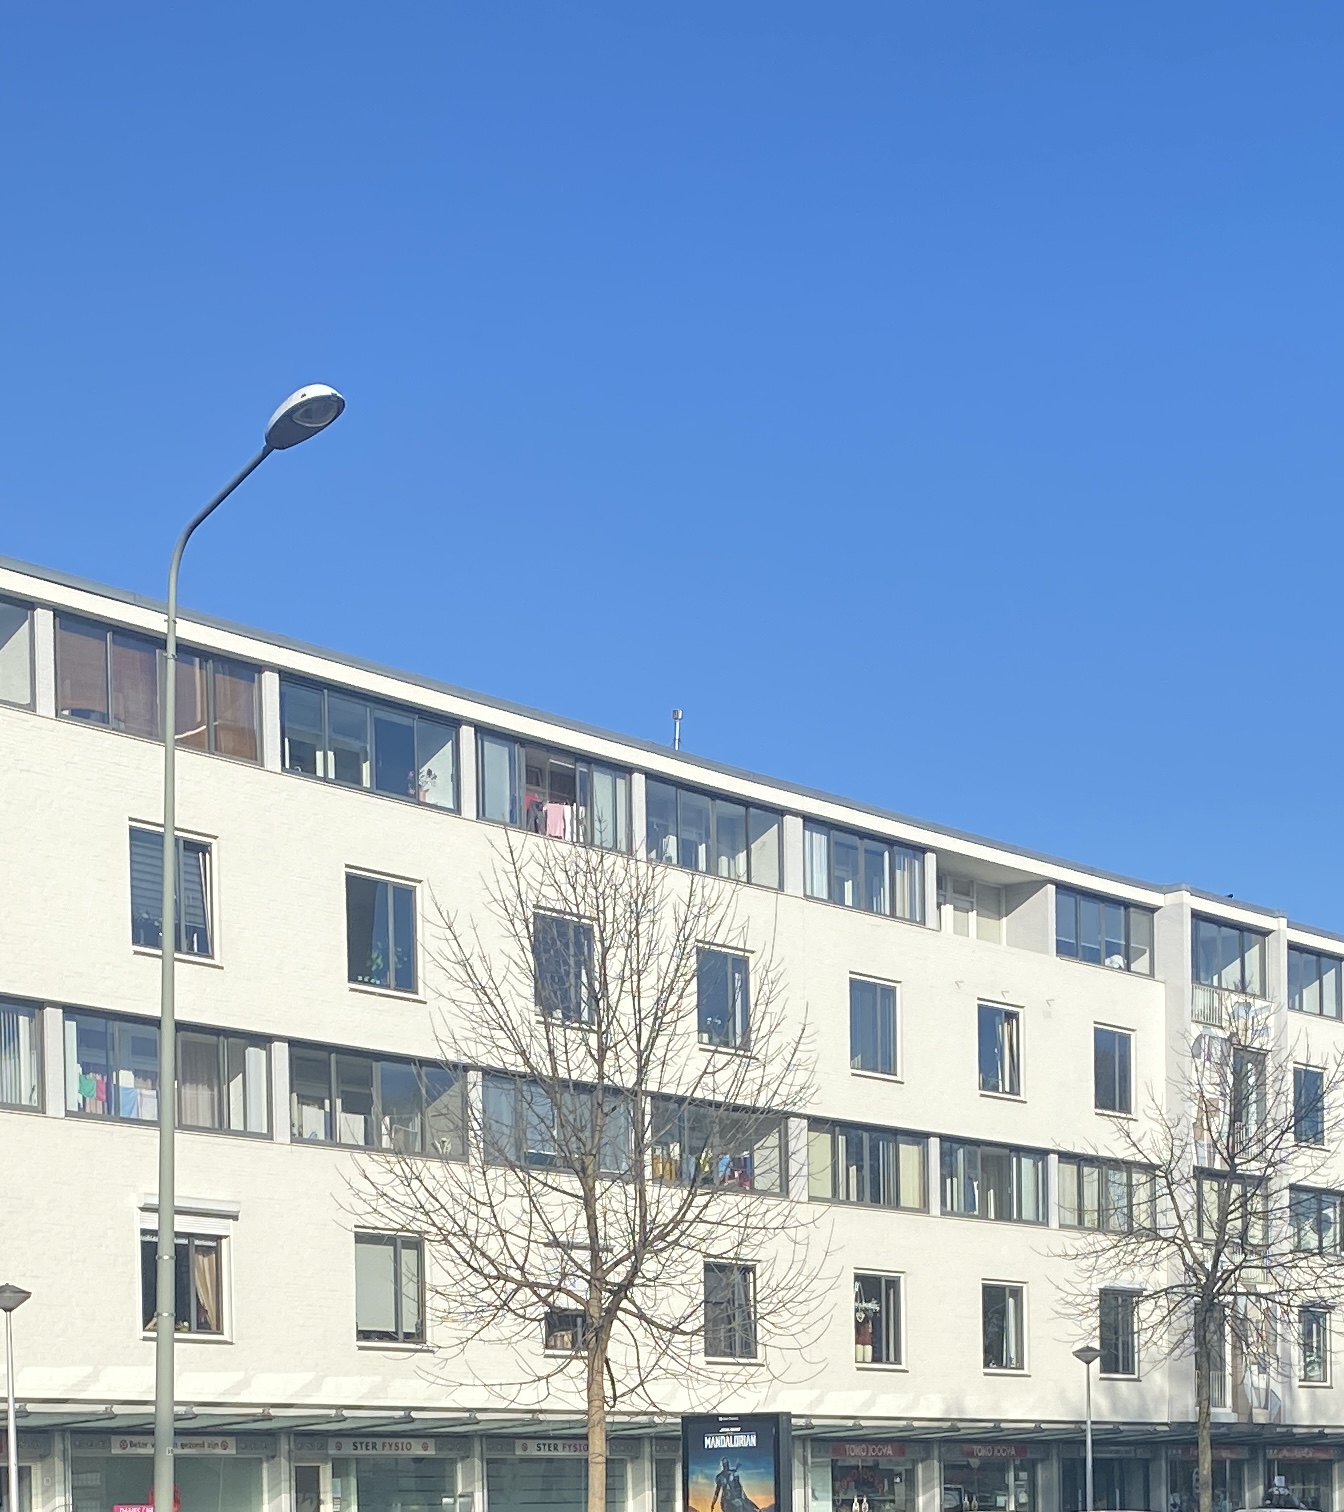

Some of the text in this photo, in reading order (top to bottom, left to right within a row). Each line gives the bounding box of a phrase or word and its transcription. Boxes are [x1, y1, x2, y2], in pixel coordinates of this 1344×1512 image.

[352, 1441, 412, 1451] STER FYSIO
[536, 1442, 558, 1452] STER
[844, 1444, 866, 1456] TOKO
[973, 1446, 993, 1457] TOKO
